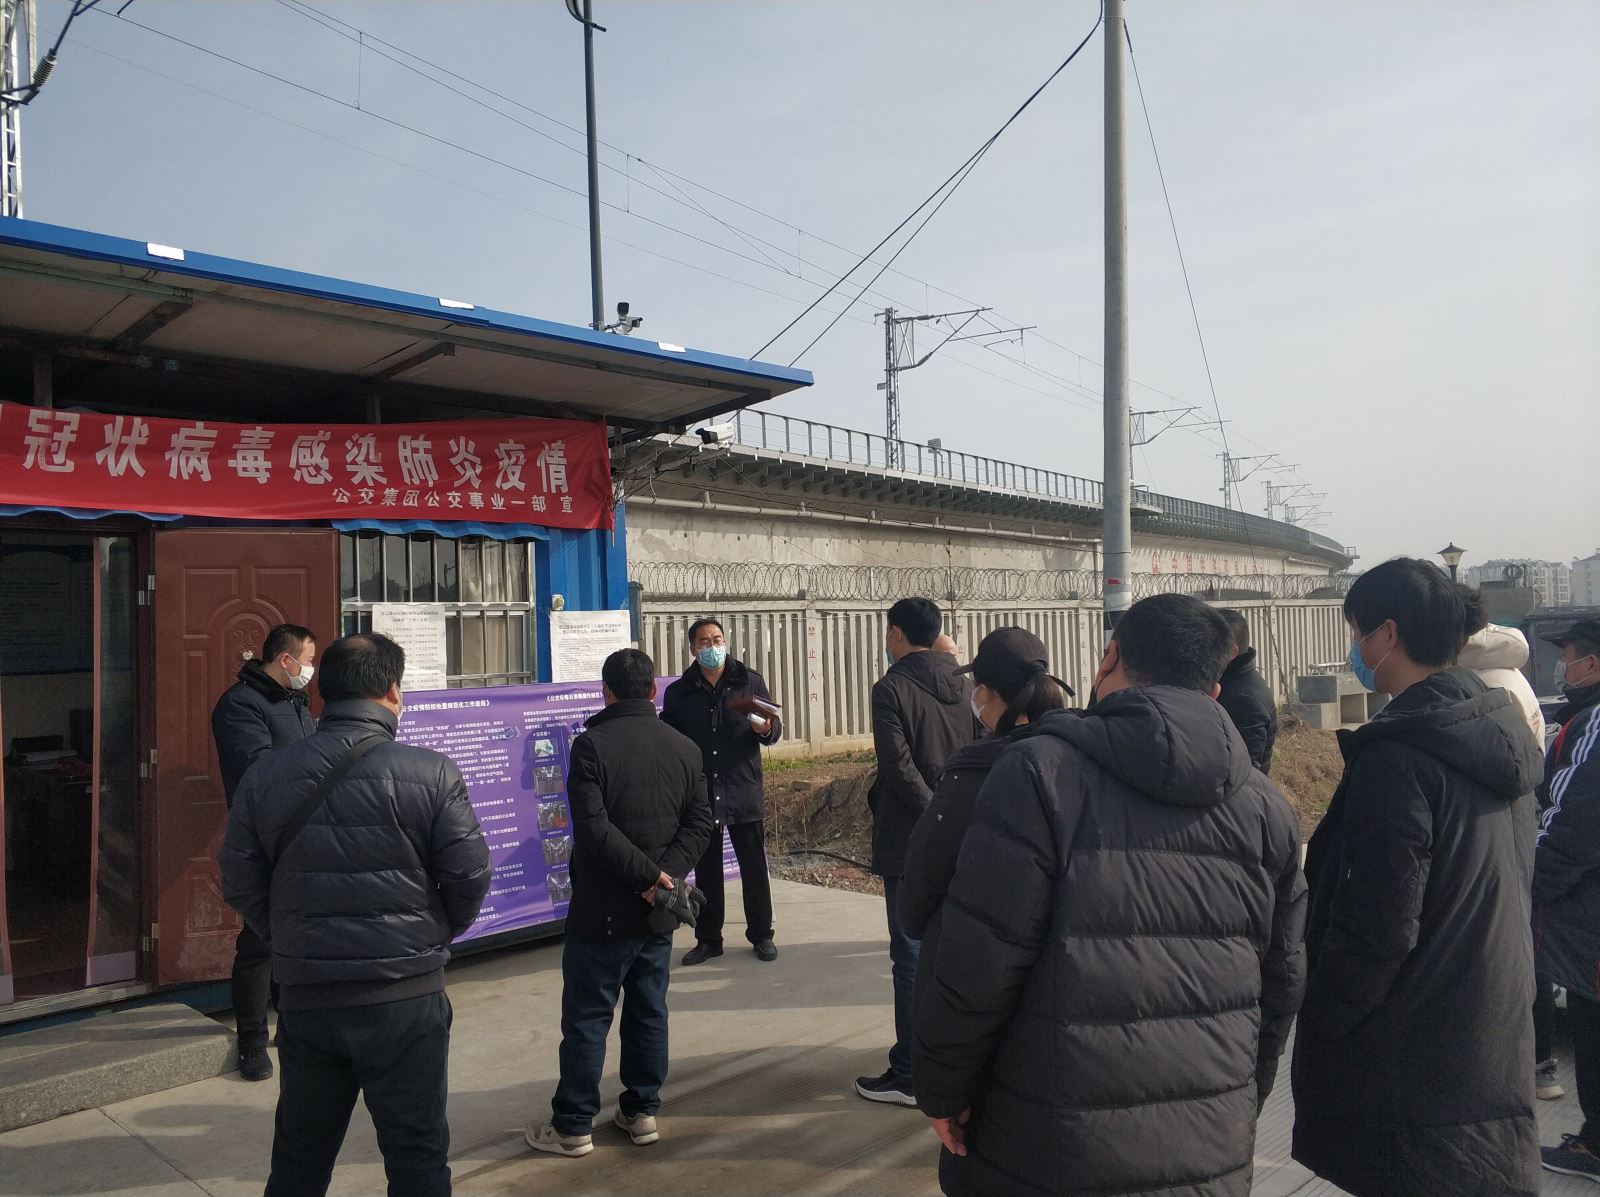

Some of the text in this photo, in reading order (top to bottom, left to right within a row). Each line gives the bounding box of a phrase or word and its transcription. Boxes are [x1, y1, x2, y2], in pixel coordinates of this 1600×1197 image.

[0, 403, 569, 494] 冠状病毒感染肺炎疫情
[808, 625, 818, 702] 禁止入内
